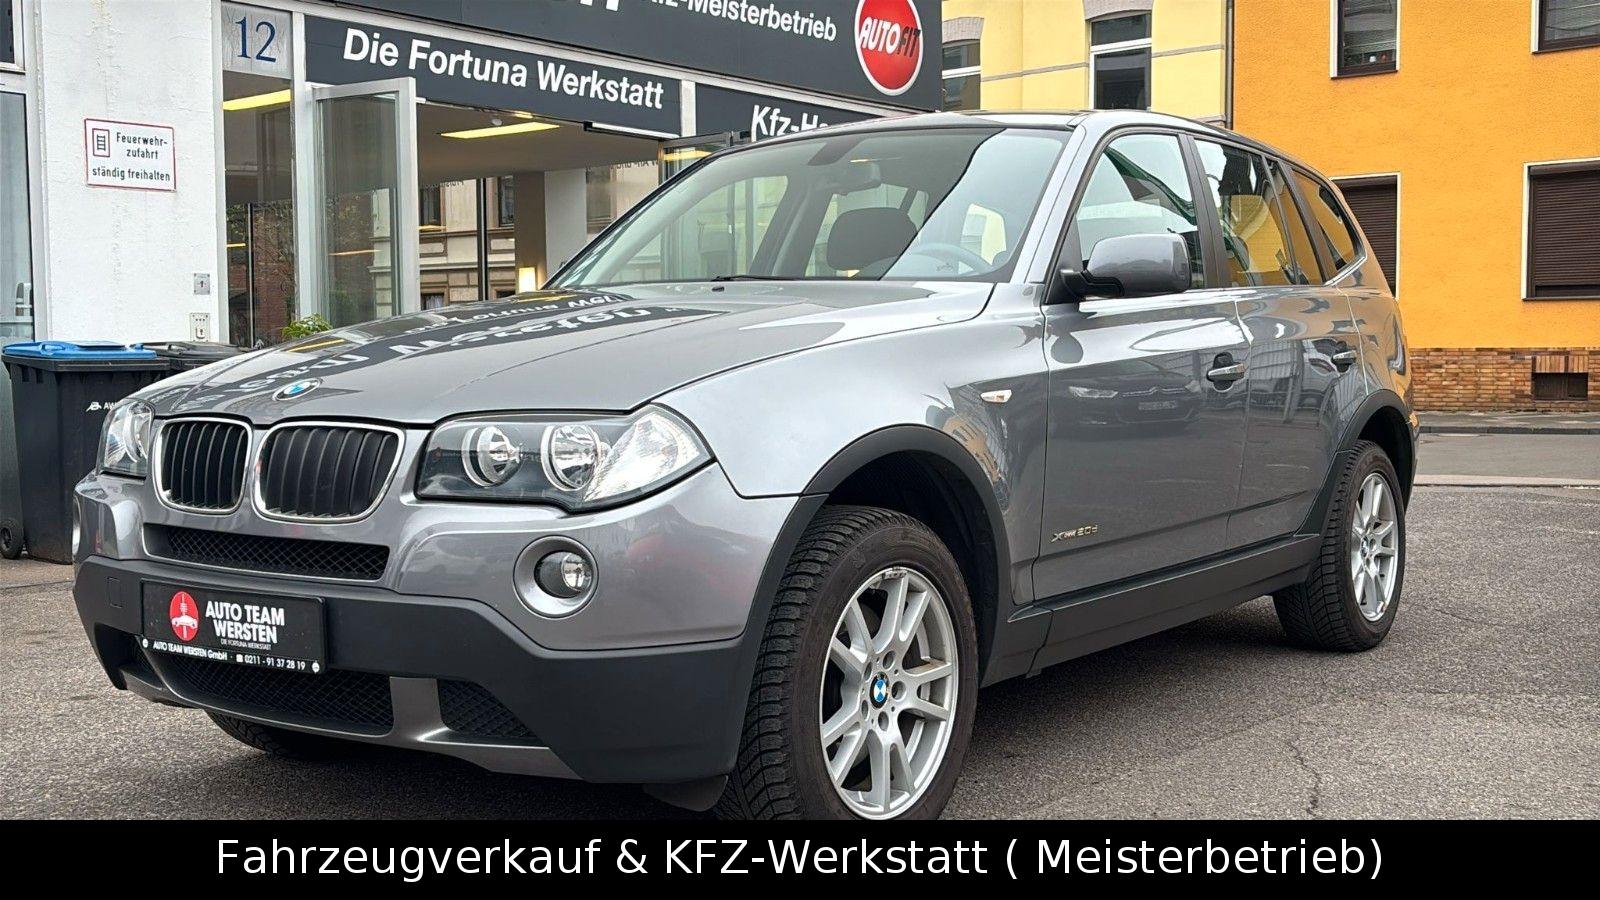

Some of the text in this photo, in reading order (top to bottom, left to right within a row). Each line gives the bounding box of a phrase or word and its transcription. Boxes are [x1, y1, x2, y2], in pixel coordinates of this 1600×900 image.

[650, 0, 838, 42] eisterbetrieb
[234, 16, 277, 63] 12
[343, 28, 664, 109] Die Fortuna Werkstatt
[751, 104, 829, 143] Kfz-H
[116, 132, 168, 147] Feuerwehr-
[126, 148, 159, 160] zufahrt
[92, 166, 171, 181] ständig freihalten
[205, 601, 285, 626] AUTO TEAM
[213, 619, 278, 644] WERSTEN
[153, 641, 167, 651] AUTO
[168, 643, 183, 654] TEAM
[183, 645, 207, 658] WERSTEN
[207, 650, 228, 661] GmbH
[245, 654, 261, 665] 0211
[266, 657, 275, 667] 91
[276, 658, 285, 668] 37
[286, 660, 296, 669] 28
[297, 661, 306, 671] 19
